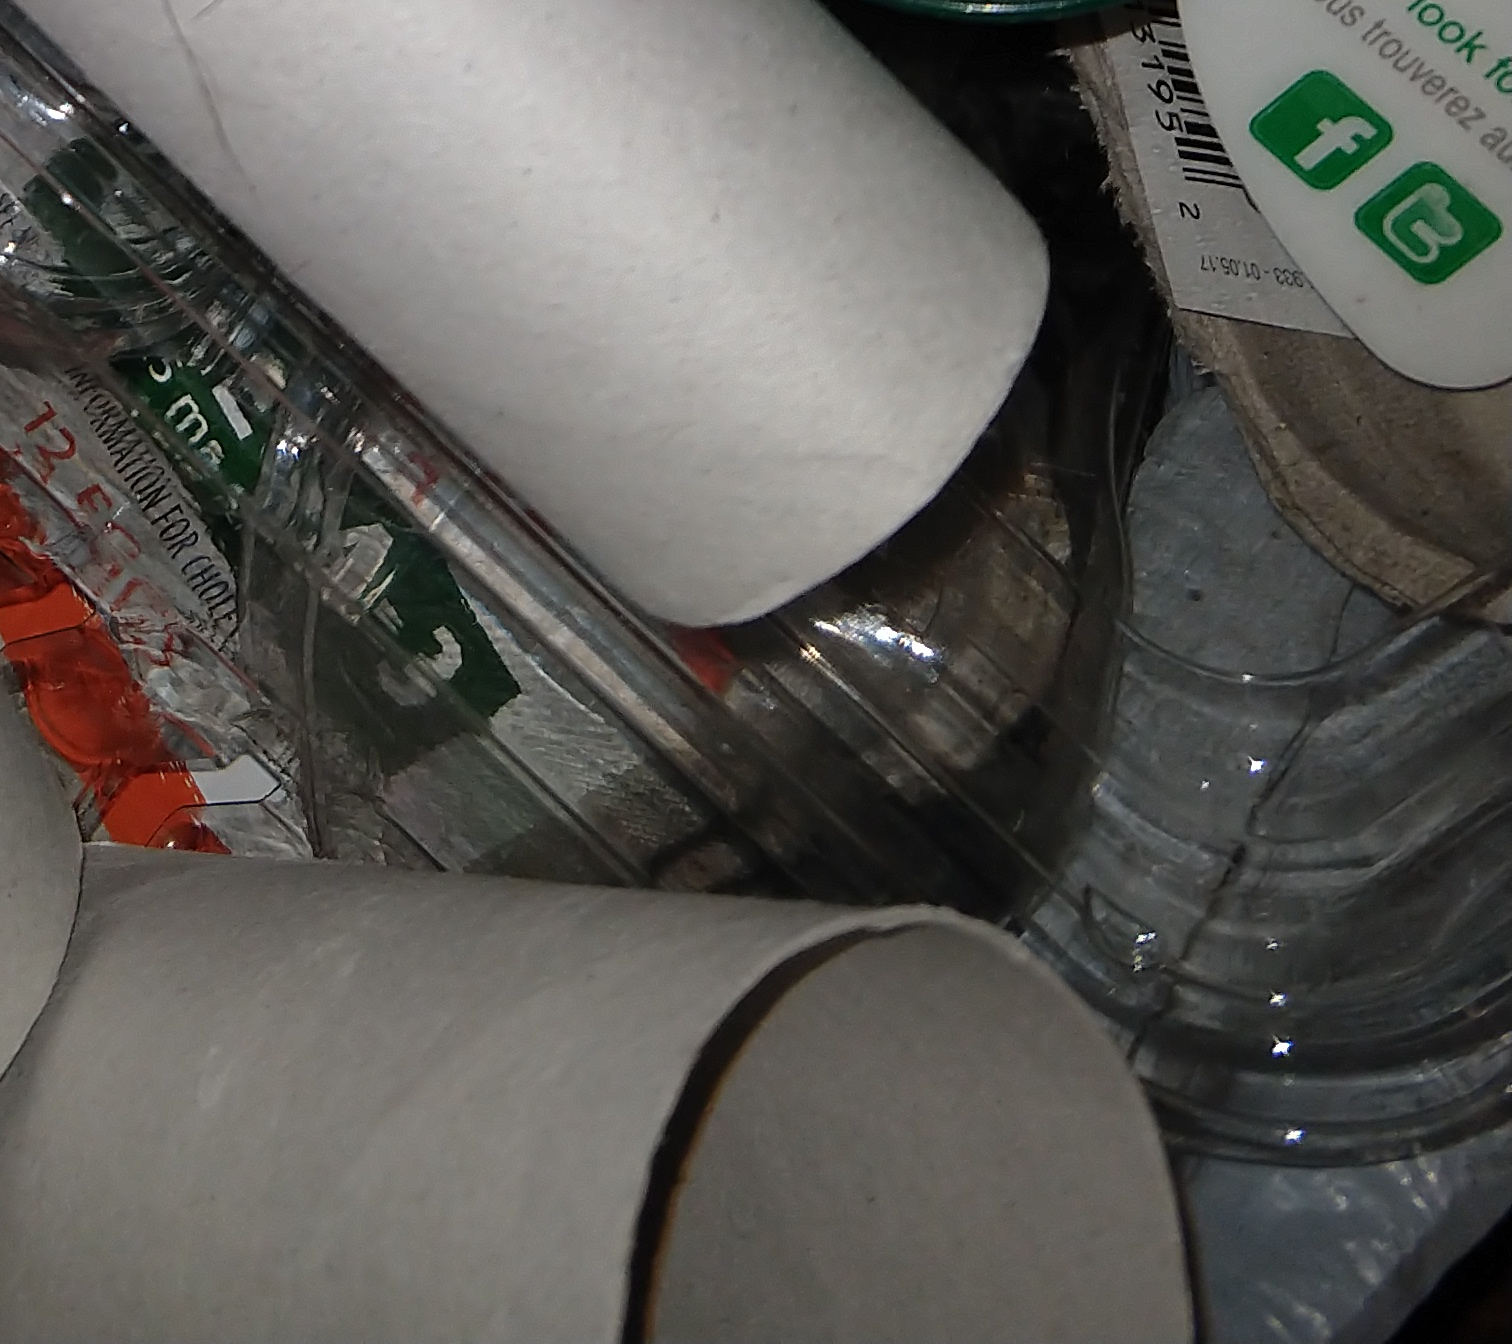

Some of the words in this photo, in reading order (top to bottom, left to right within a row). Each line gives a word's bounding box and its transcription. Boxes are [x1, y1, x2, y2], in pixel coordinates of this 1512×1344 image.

[1361, 18, 1487, 132] trouverez
[1178, 201, 1201, 221] 2
[149, 504, 200, 560] FOR
